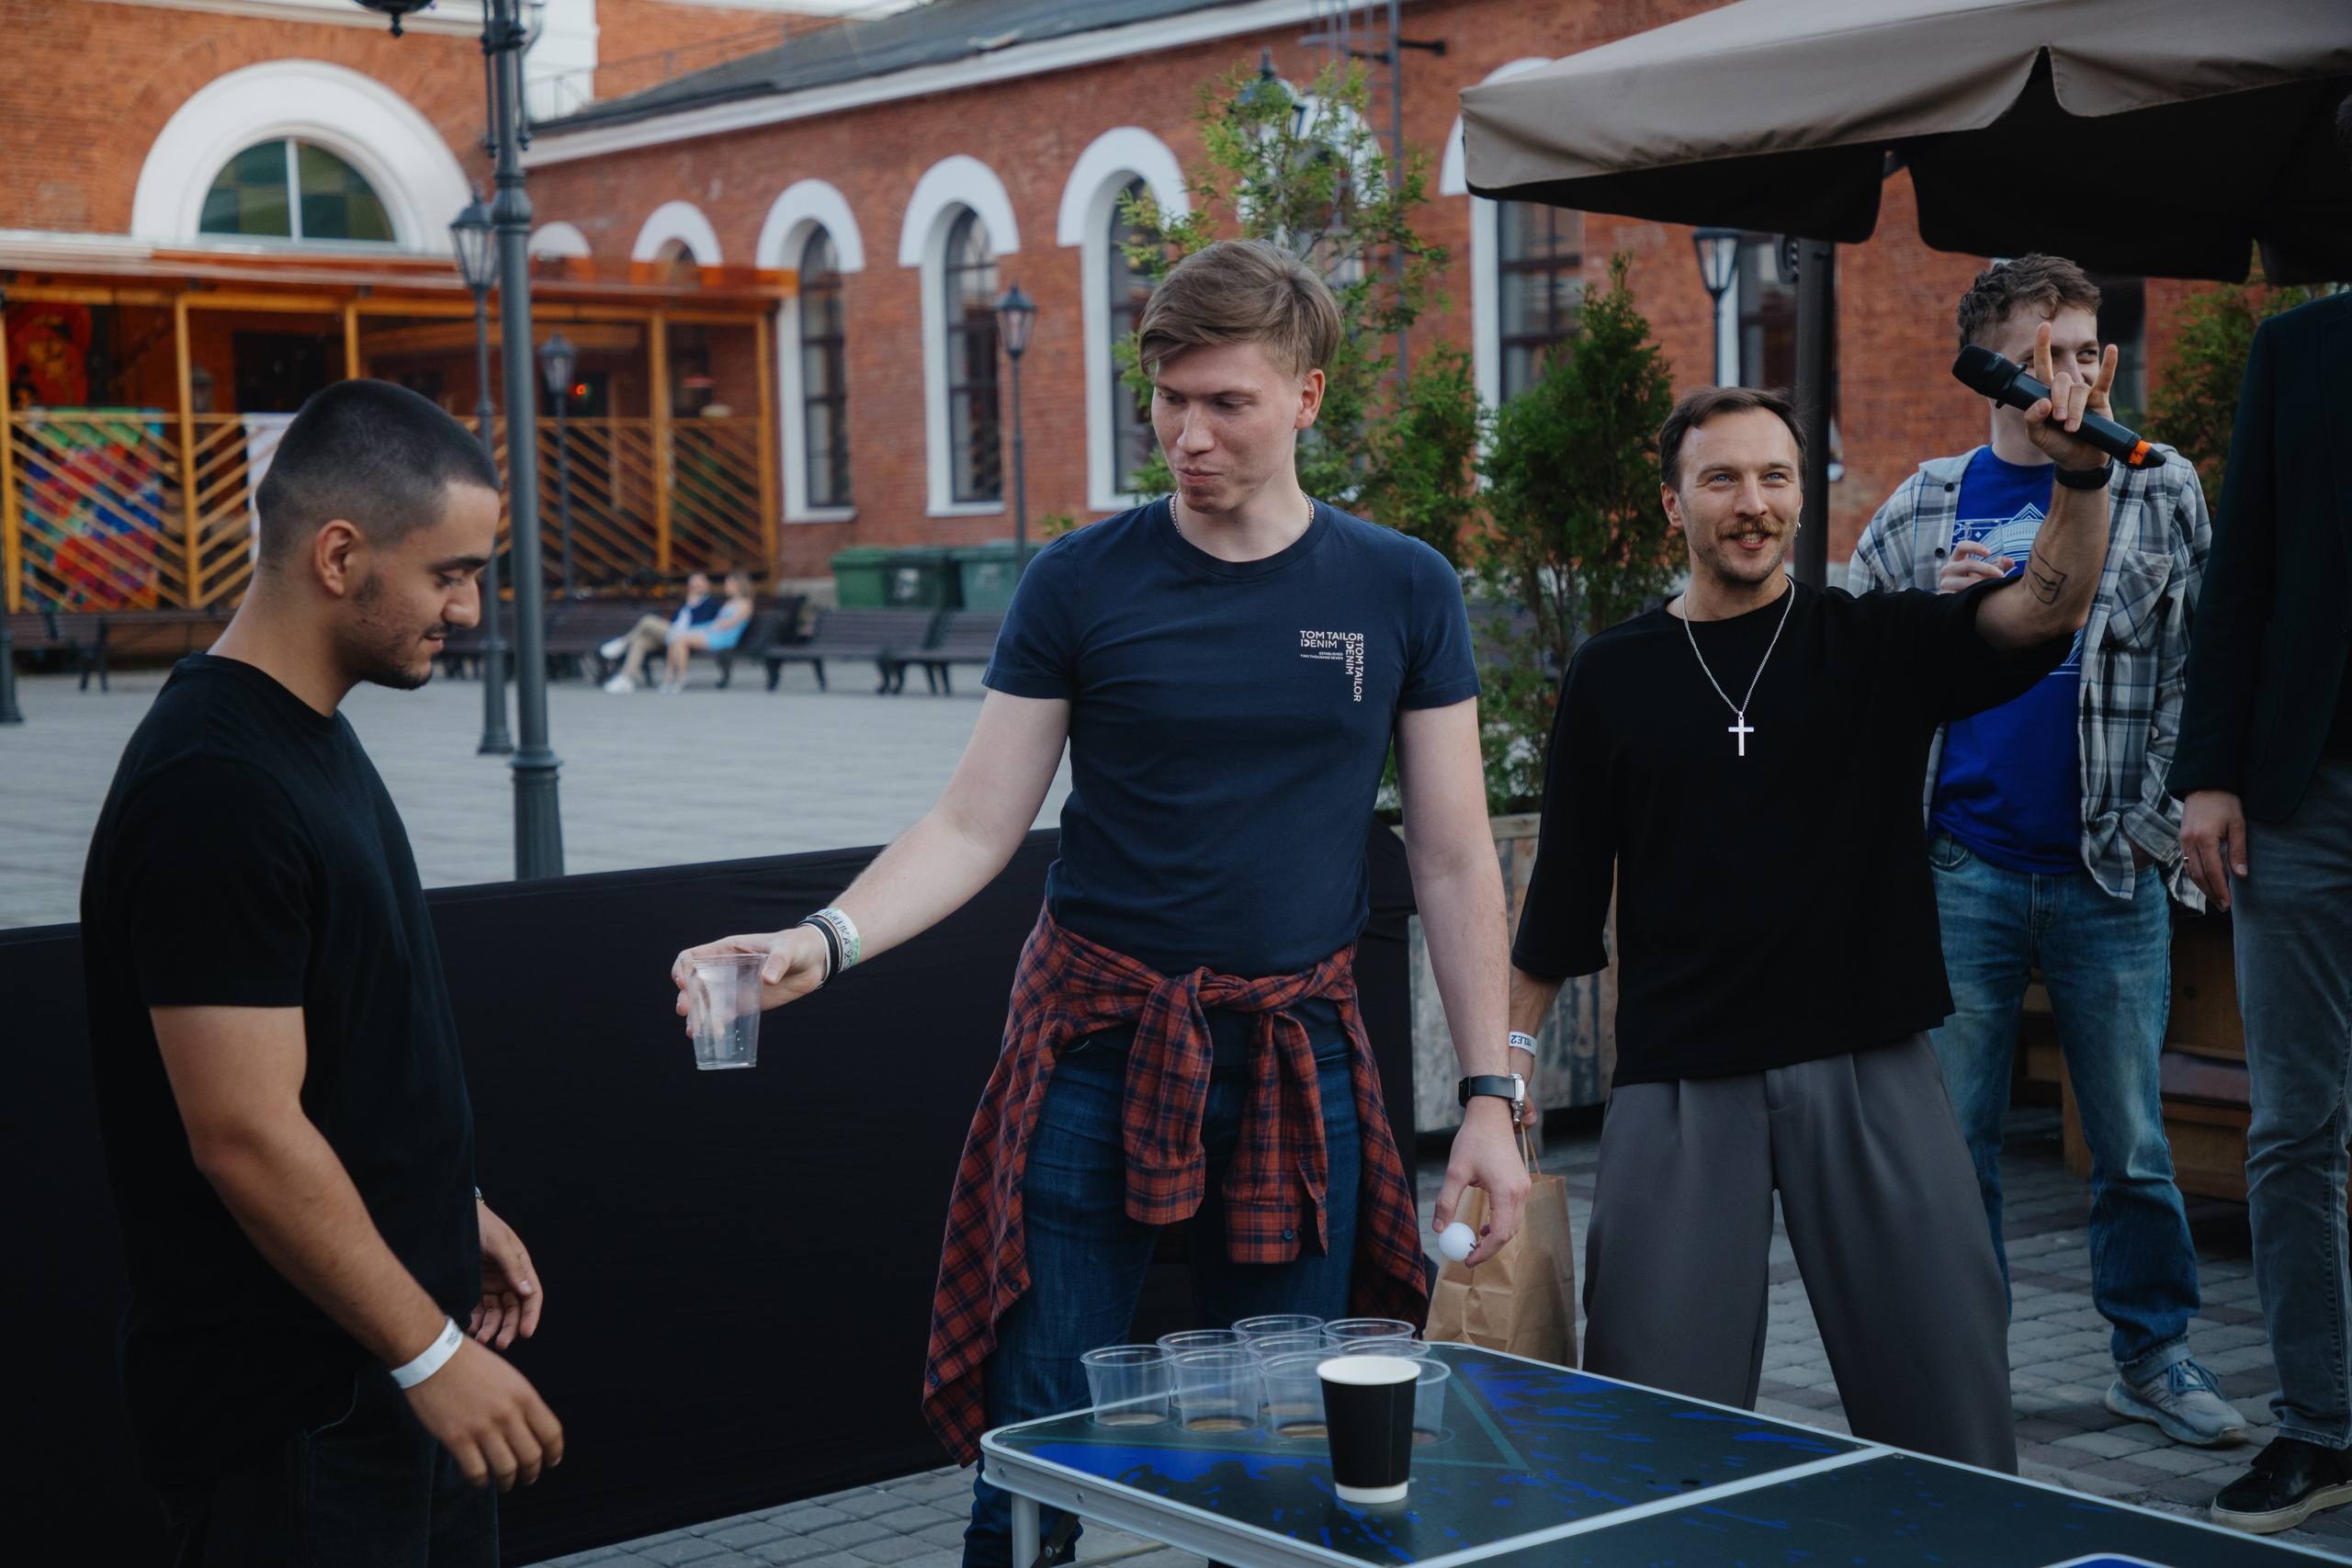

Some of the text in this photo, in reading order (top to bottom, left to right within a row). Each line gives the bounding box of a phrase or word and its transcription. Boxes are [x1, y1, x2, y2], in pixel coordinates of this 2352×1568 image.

[1300, 630, 1363, 641] TOM TAILOR
[1300, 638, 1338, 649] DENIM
[1345, 640, 1354, 675] DENIM
[1353, 642, 1364, 702] TOM TAILOR
[1510, 1034, 1532, 1046] TELE2
